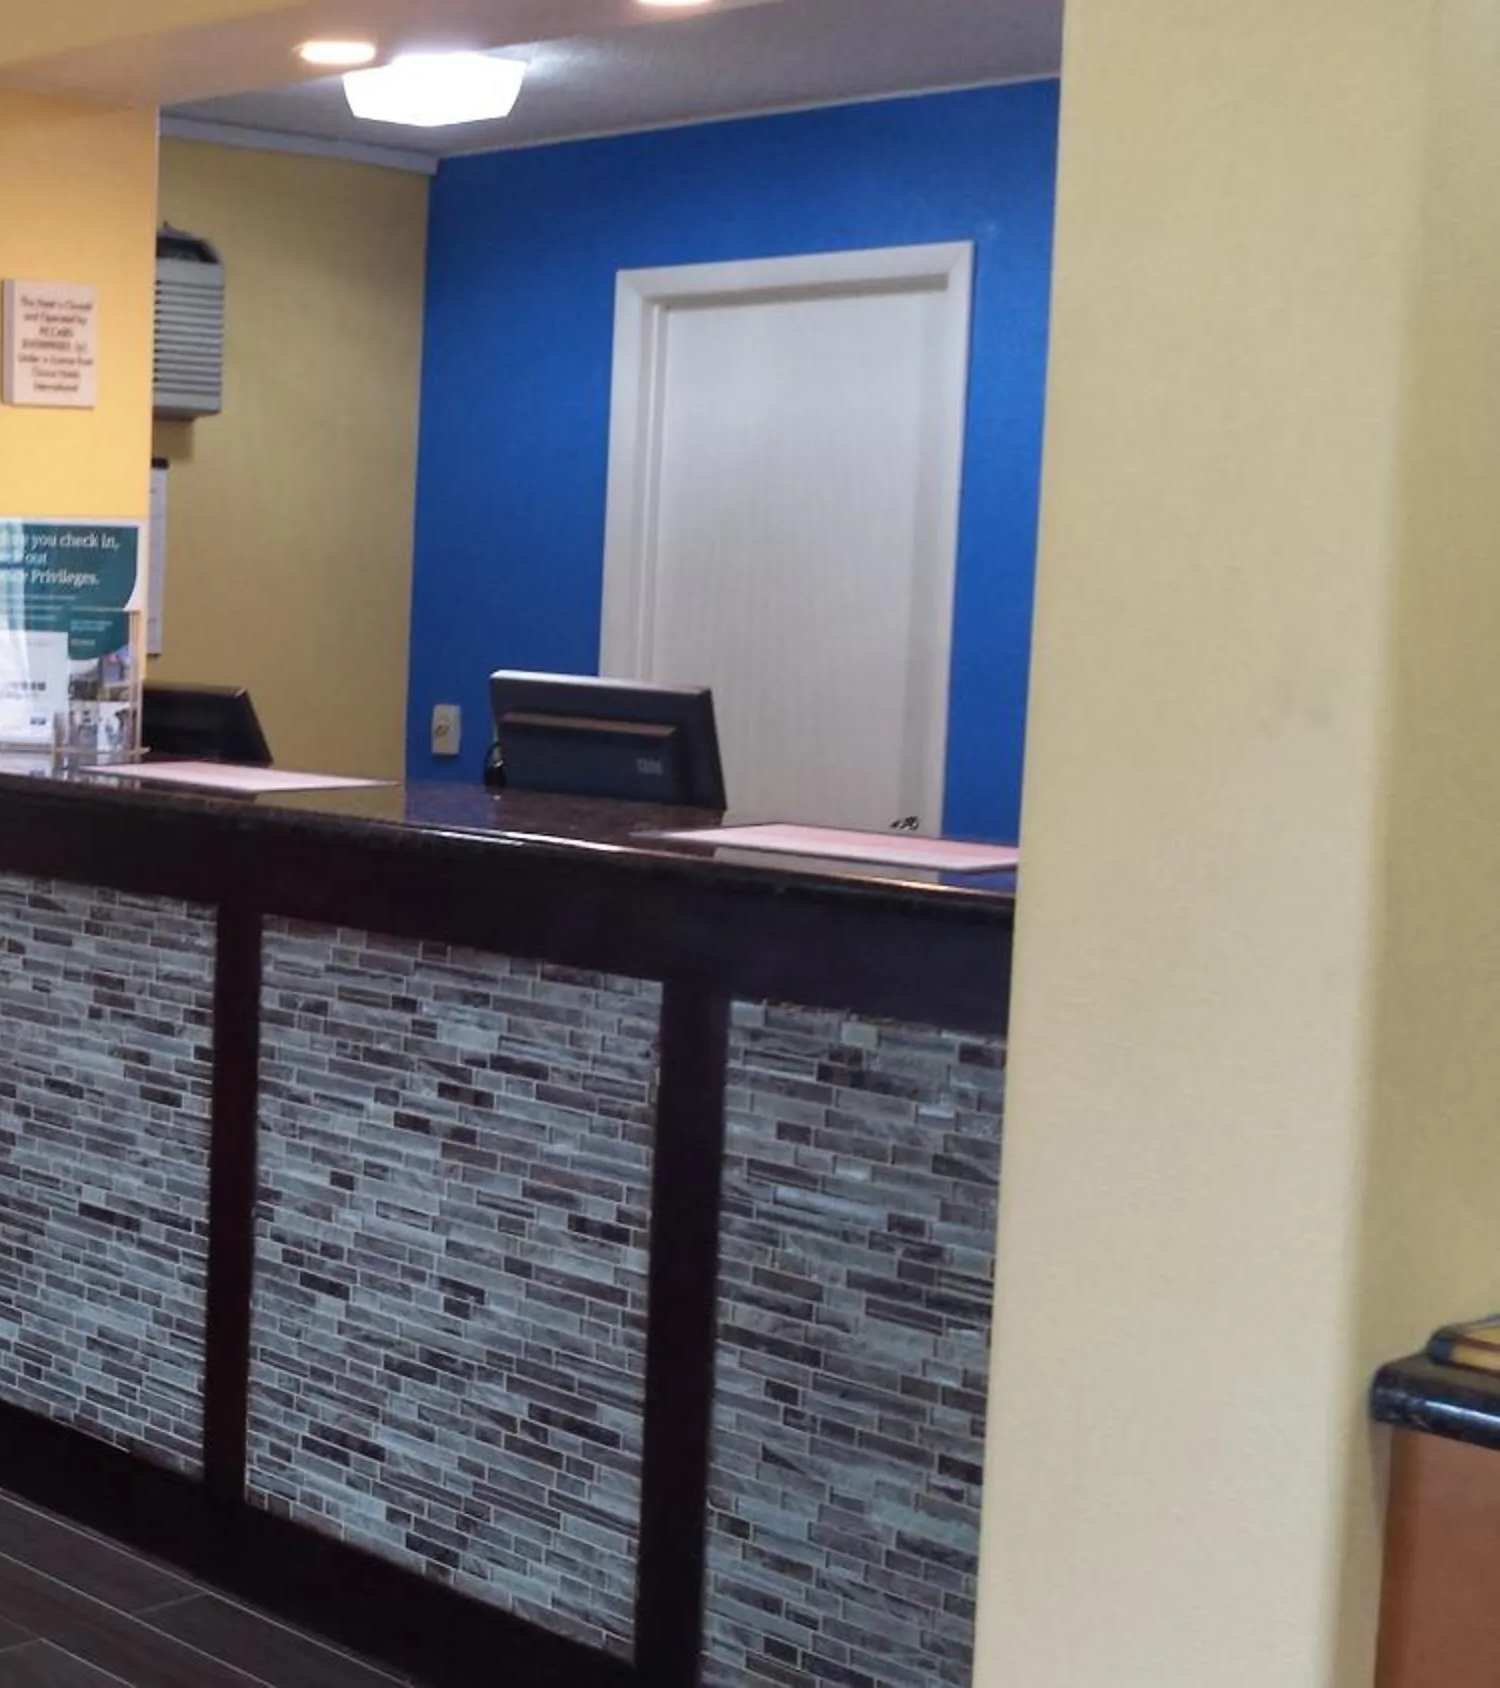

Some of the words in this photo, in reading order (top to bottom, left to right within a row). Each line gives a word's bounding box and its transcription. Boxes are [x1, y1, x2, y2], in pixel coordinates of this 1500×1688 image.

[31, 533, 56, 549] you
[59, 531, 98, 548] check
[25, 552, 47, 564] out
[31, 569, 99, 587] Privileges.
